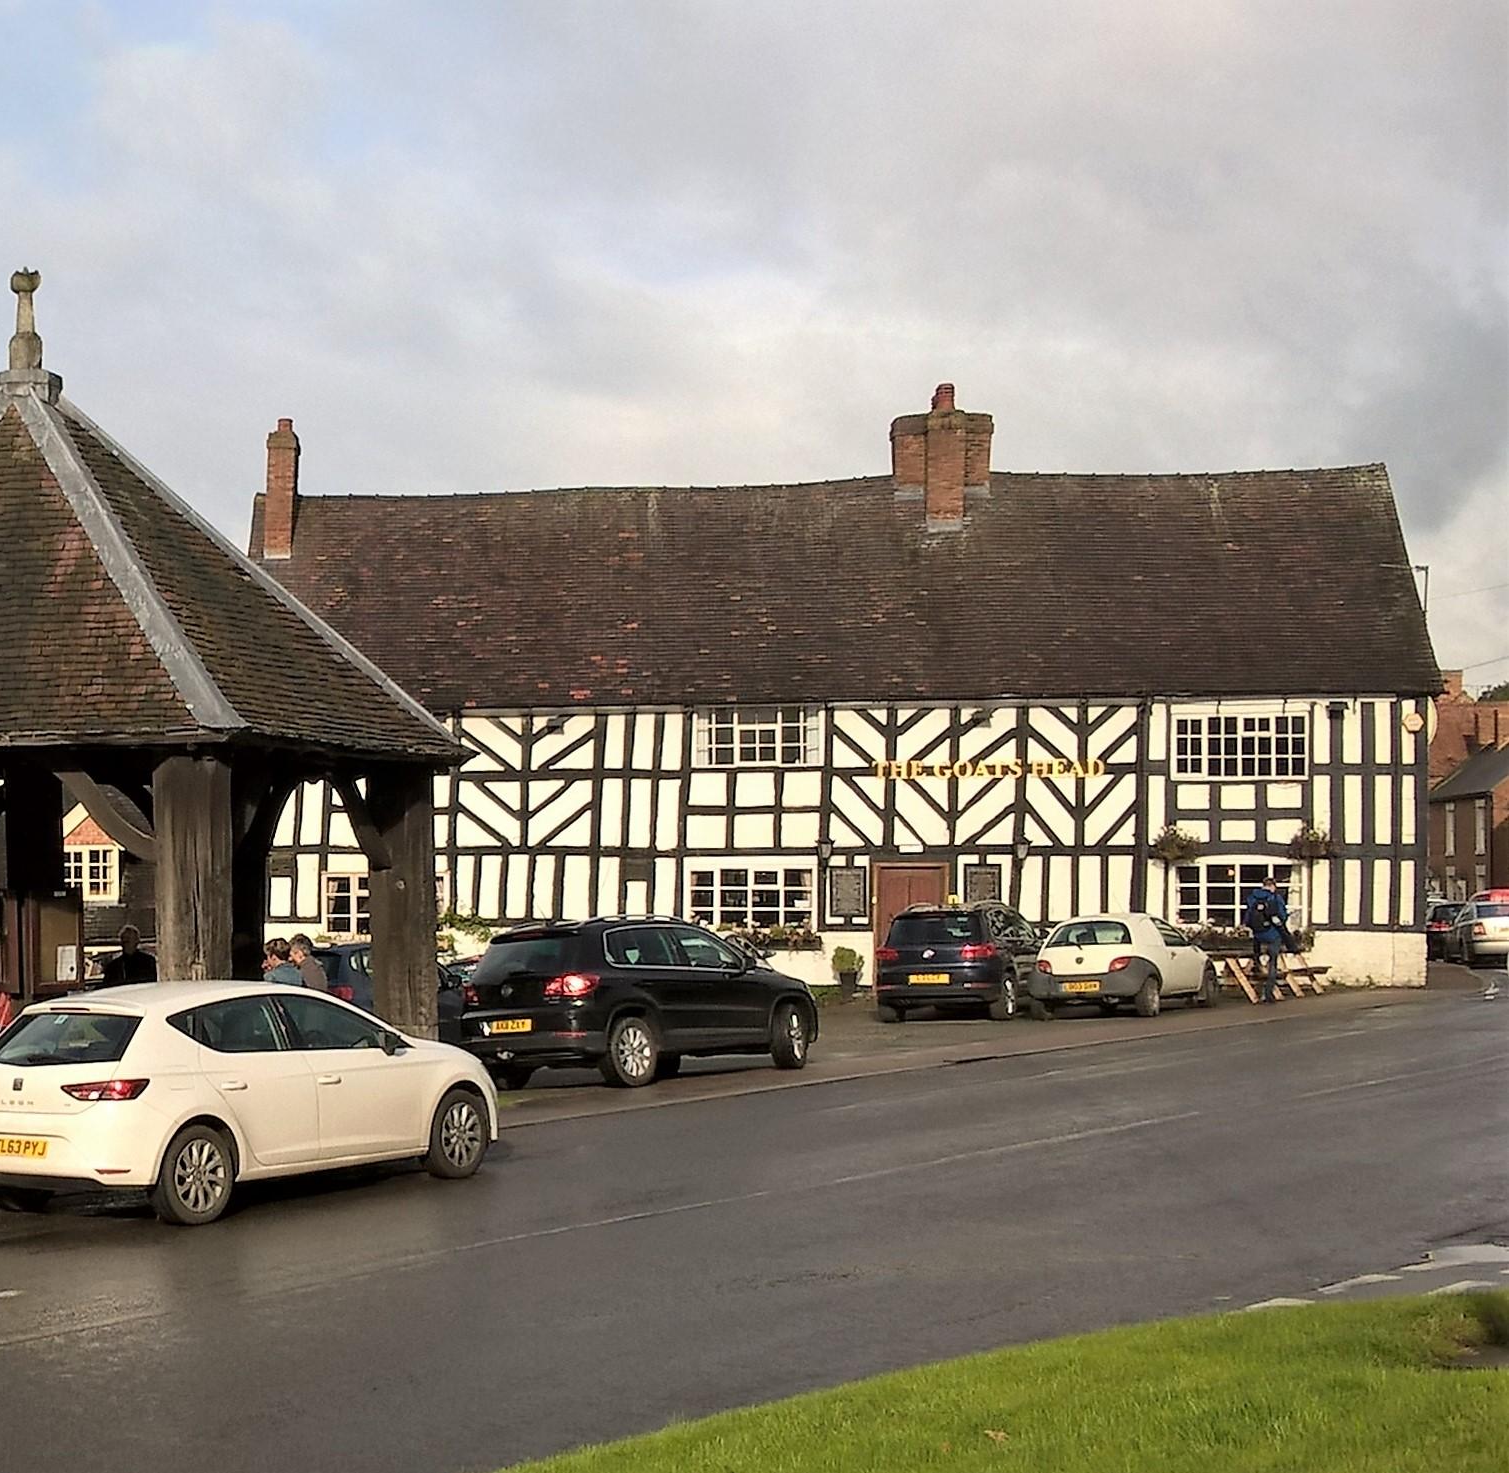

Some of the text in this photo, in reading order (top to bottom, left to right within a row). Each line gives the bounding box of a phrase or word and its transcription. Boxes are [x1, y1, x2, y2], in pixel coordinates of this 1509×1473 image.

[872, 757, 1105, 780] THE GOATS HEAD
[23, 1140, 47, 1156] PYJ
